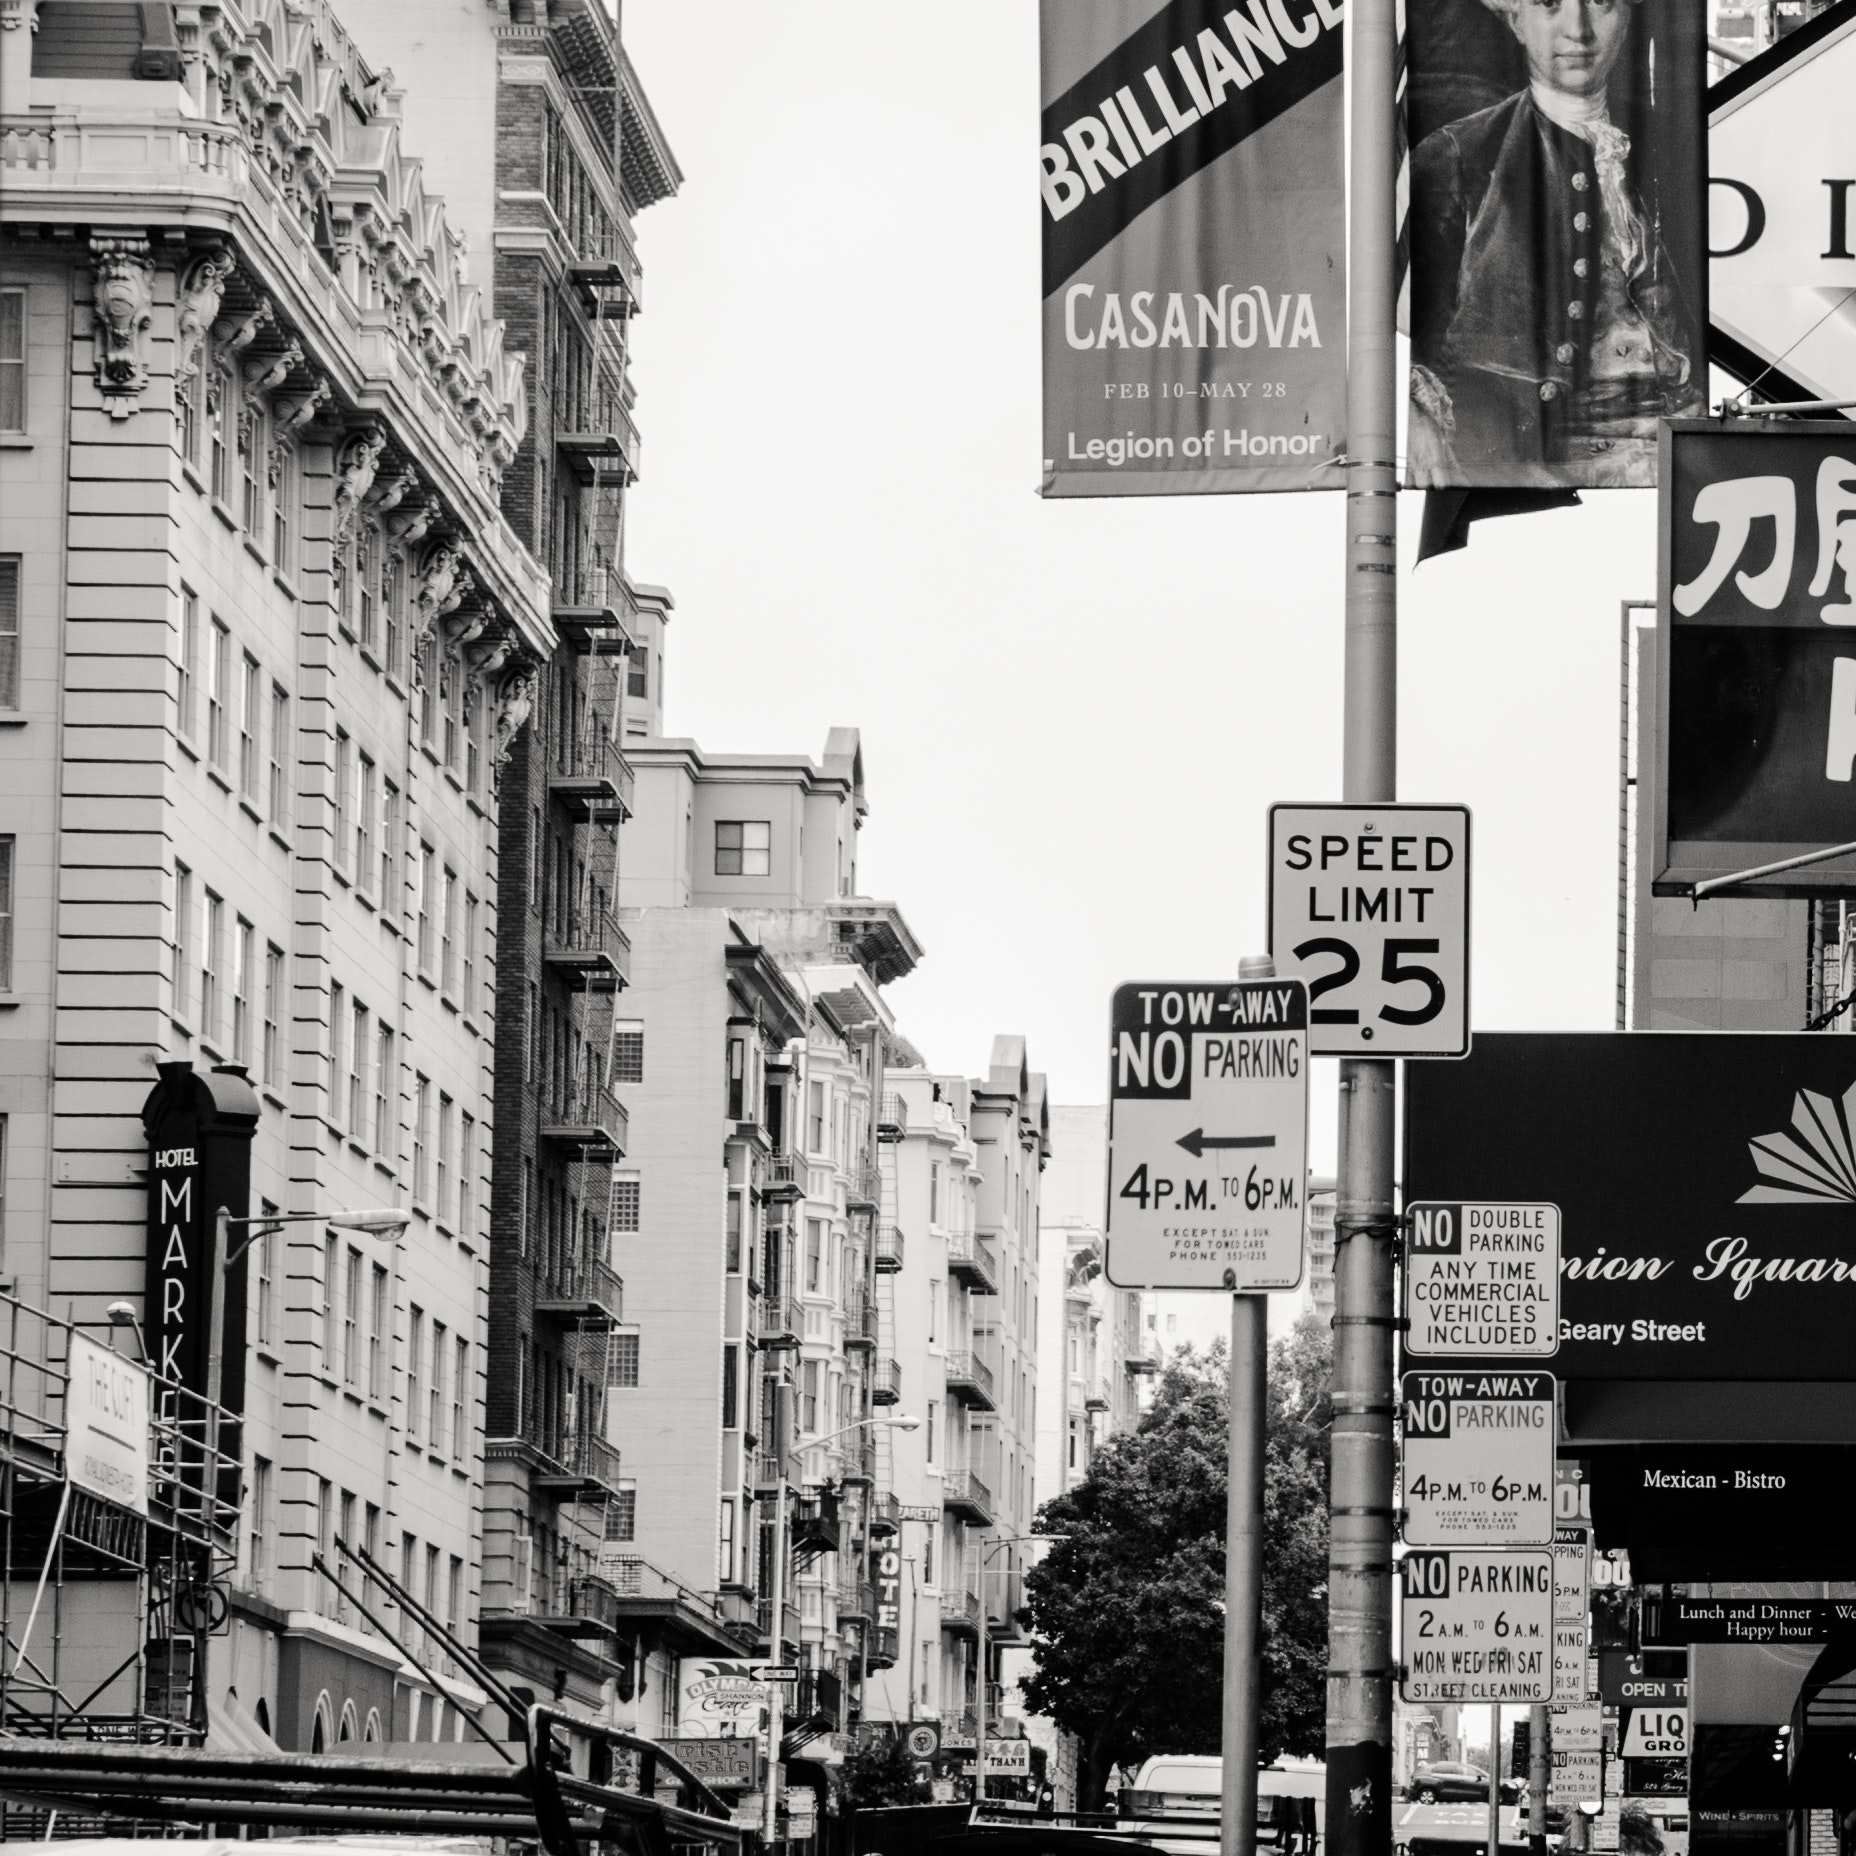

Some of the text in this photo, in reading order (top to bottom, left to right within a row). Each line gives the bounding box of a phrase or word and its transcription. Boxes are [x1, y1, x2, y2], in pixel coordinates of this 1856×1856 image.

[1065, 283, 1322, 350] CASANOVA
[1104, 383, 1150, 399] FEB
[1262, 382, 1287, 397] 28
[1067, 429, 1322, 466] Legion of Honor
[1285, 835, 1454, 872] SPEED
[1309, 887, 1434, 923] LIMIT
[1292, 937, 1446, 1026] 25
[1138, 989, 1292, 1025] TOW-AWAY
[1119, 1031, 1299, 1088] NO PARKING
[155, 1147, 198, 1169] HOTEL
[1222, 1177, 1239, 1197] TO
[1163, 1228, 1218, 1237] EXCEPT
[1415, 1209, 1544, 1247] NO DOUBLE
[1470, 1234, 1545, 1252] PARKING
[1170, 1252, 1217, 1260] PHONE
[1560, 1247, 1675, 1282] nion
[1430, 1261, 1536, 1280] ANY TIME
[1416, 1283, 1550, 1302] COMMERCIAL
[1430, 1304, 1536, 1323] VEHICLES
[1558, 1318, 1706, 1345] Geary Street
[1418, 1377, 1539, 1397] TOW-AWAY
[1407, 1399, 1545, 1433] NO PARKING
[1470, 1482, 1486, 1494] TO
[1643, 1469, 1787, 1490] Mexican Bistro
[1408, 1556, 1549, 1596] NO PARKING
[1680, 1604, 1725, 1620] Lunch
[1729, 1604, 1756, 1620] and
[1761, 1604, 1812, 1620] Dinner
[1473, 1620, 1485, 1631] TO
[1727, 1621, 1813, 1641] Happy hour
[1413, 1650, 1544, 1675] MON WED FRI SAT
[1414, 1683, 1542, 1698] STREET CLEANING
[1621, 1682, 1666, 1697] OPEN
[1552, 1752, 1600, 1767] NO PARKING
